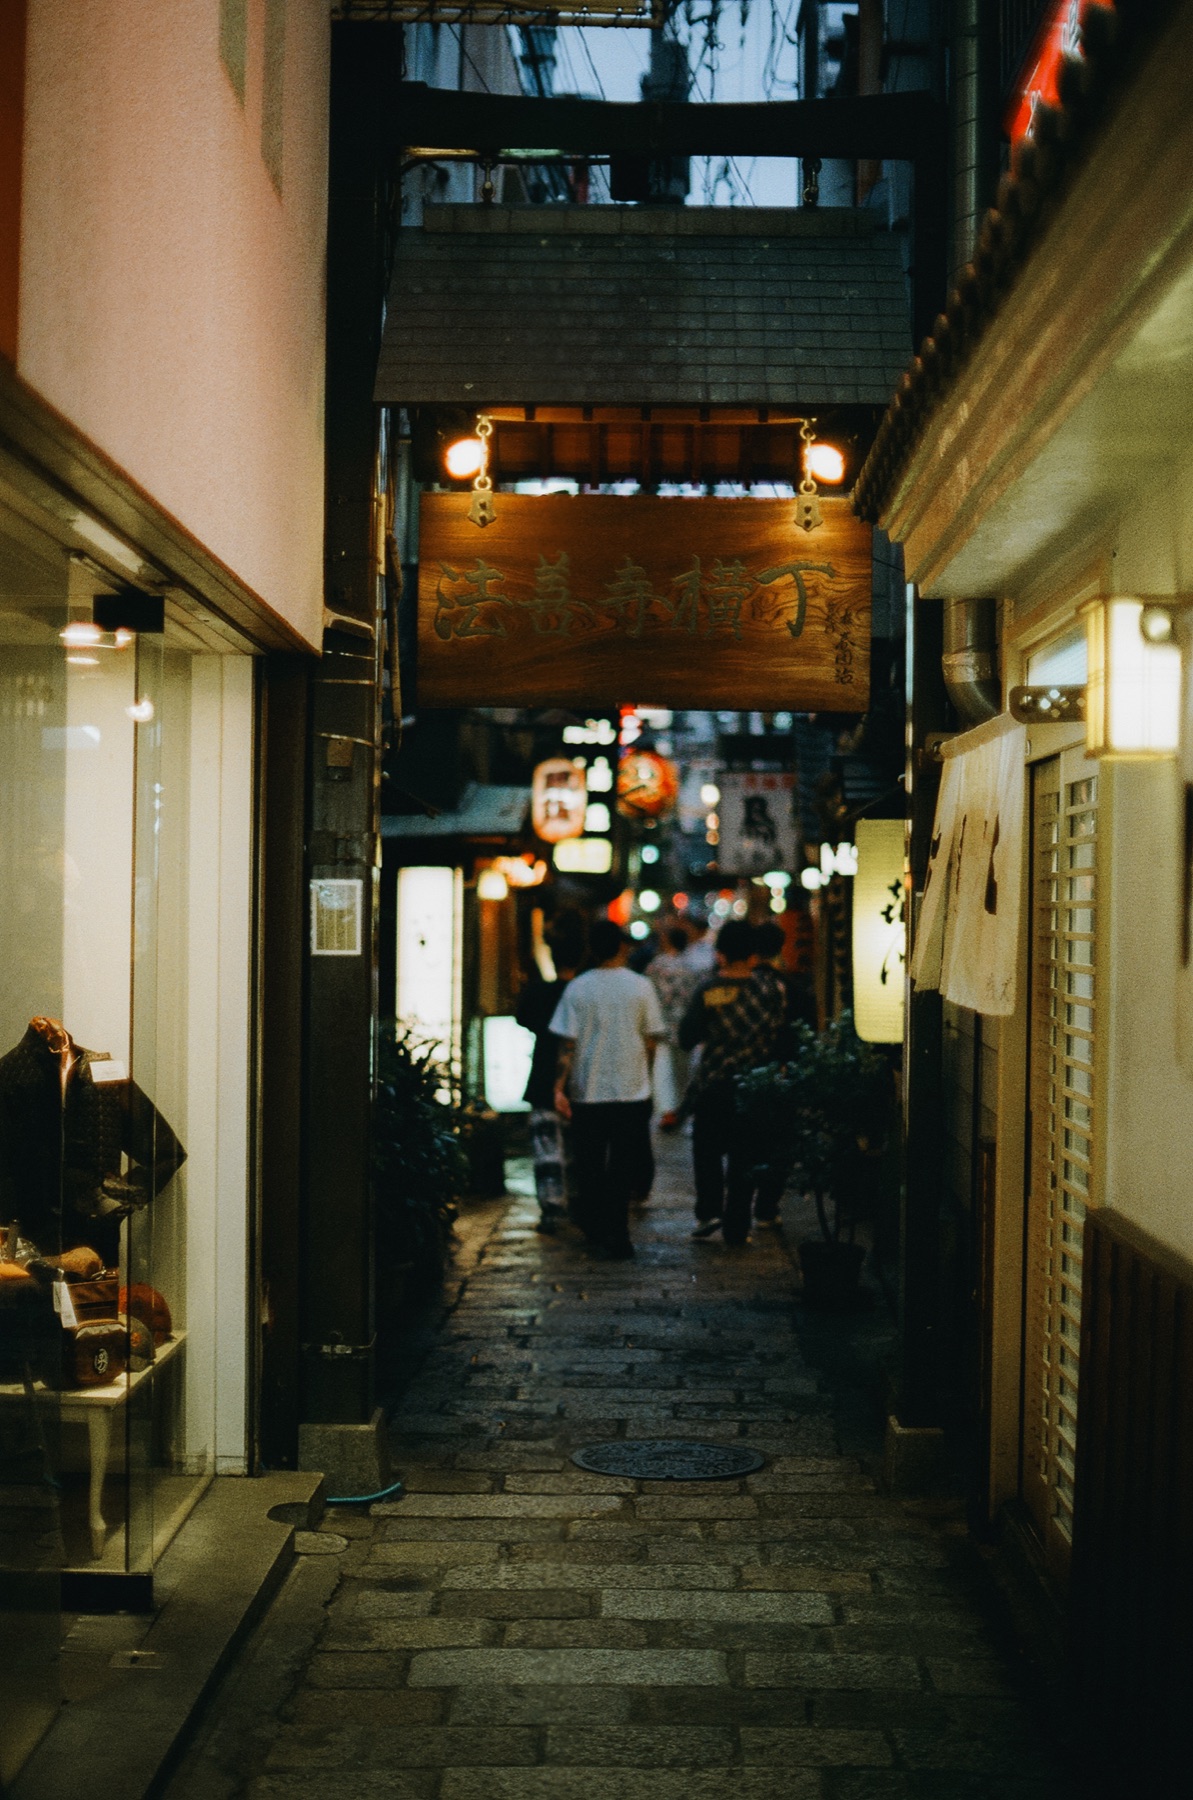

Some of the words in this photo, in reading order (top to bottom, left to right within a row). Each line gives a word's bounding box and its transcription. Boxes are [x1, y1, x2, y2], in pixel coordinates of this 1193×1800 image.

[435, 552, 835, 639] 法善寺横丁
